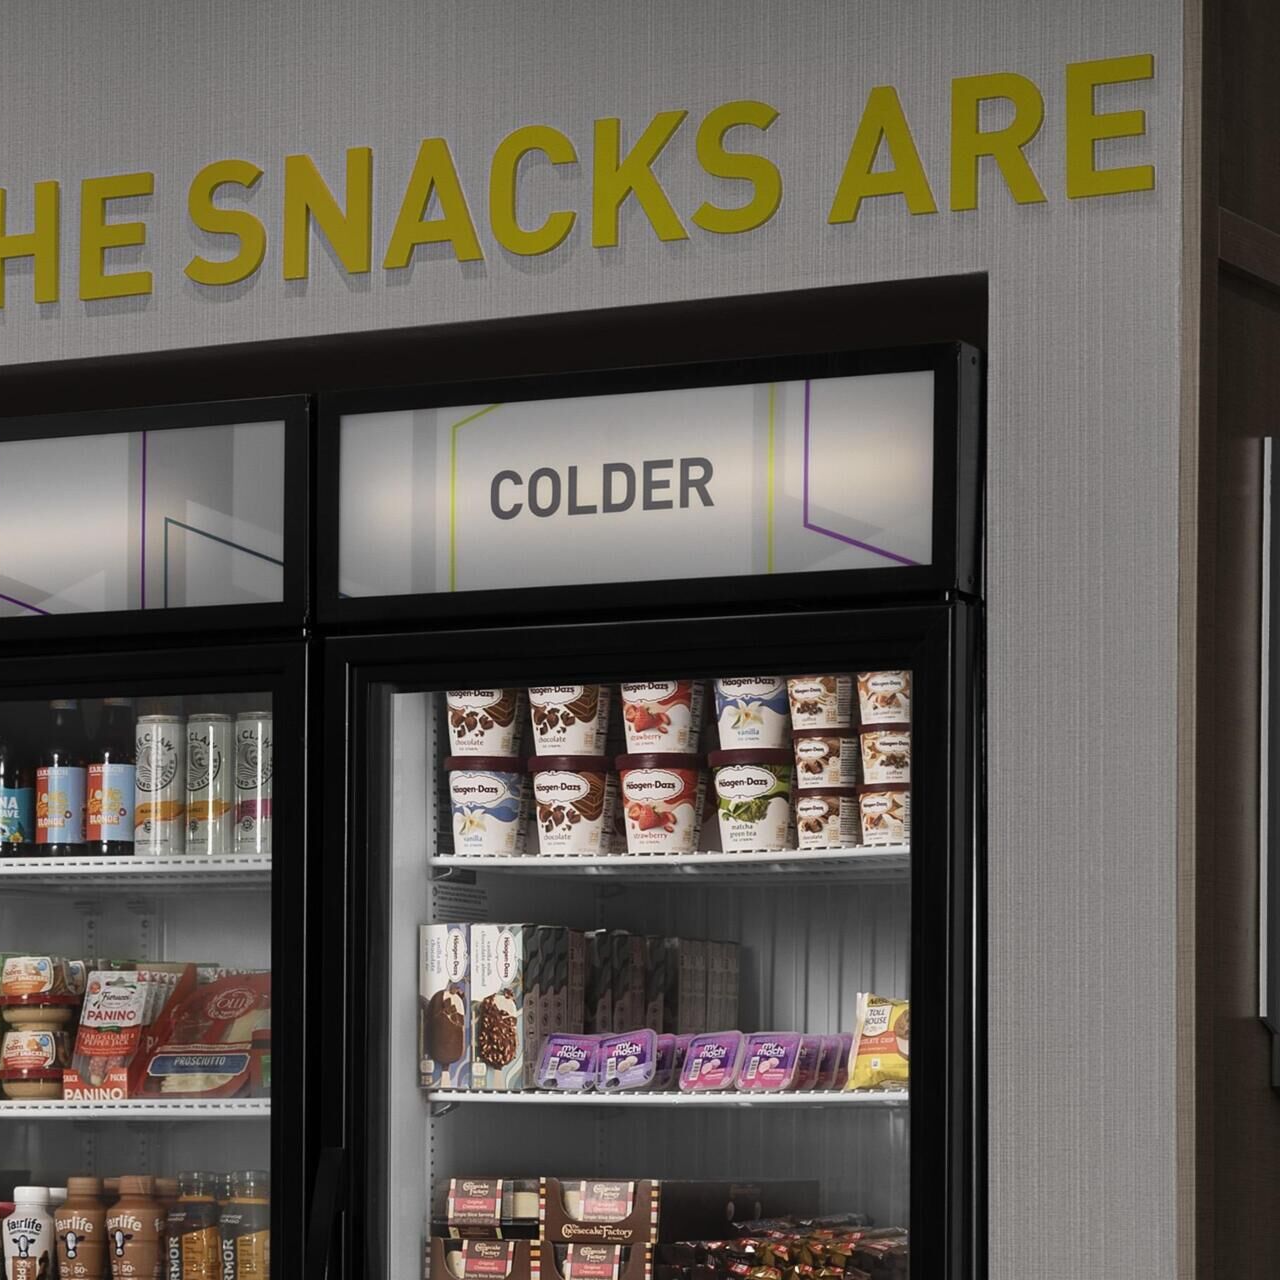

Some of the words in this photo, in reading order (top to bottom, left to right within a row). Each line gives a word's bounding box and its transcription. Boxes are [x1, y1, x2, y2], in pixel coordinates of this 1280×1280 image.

[183, 100, 783, 286] SNACKS
[828, 54, 1155, 224] ARE
[490, 457, 715, 521] COLDER
[87, 1009, 136, 1021] PANINO
[174, 1056, 225, 1067] PROSCIUTTO
